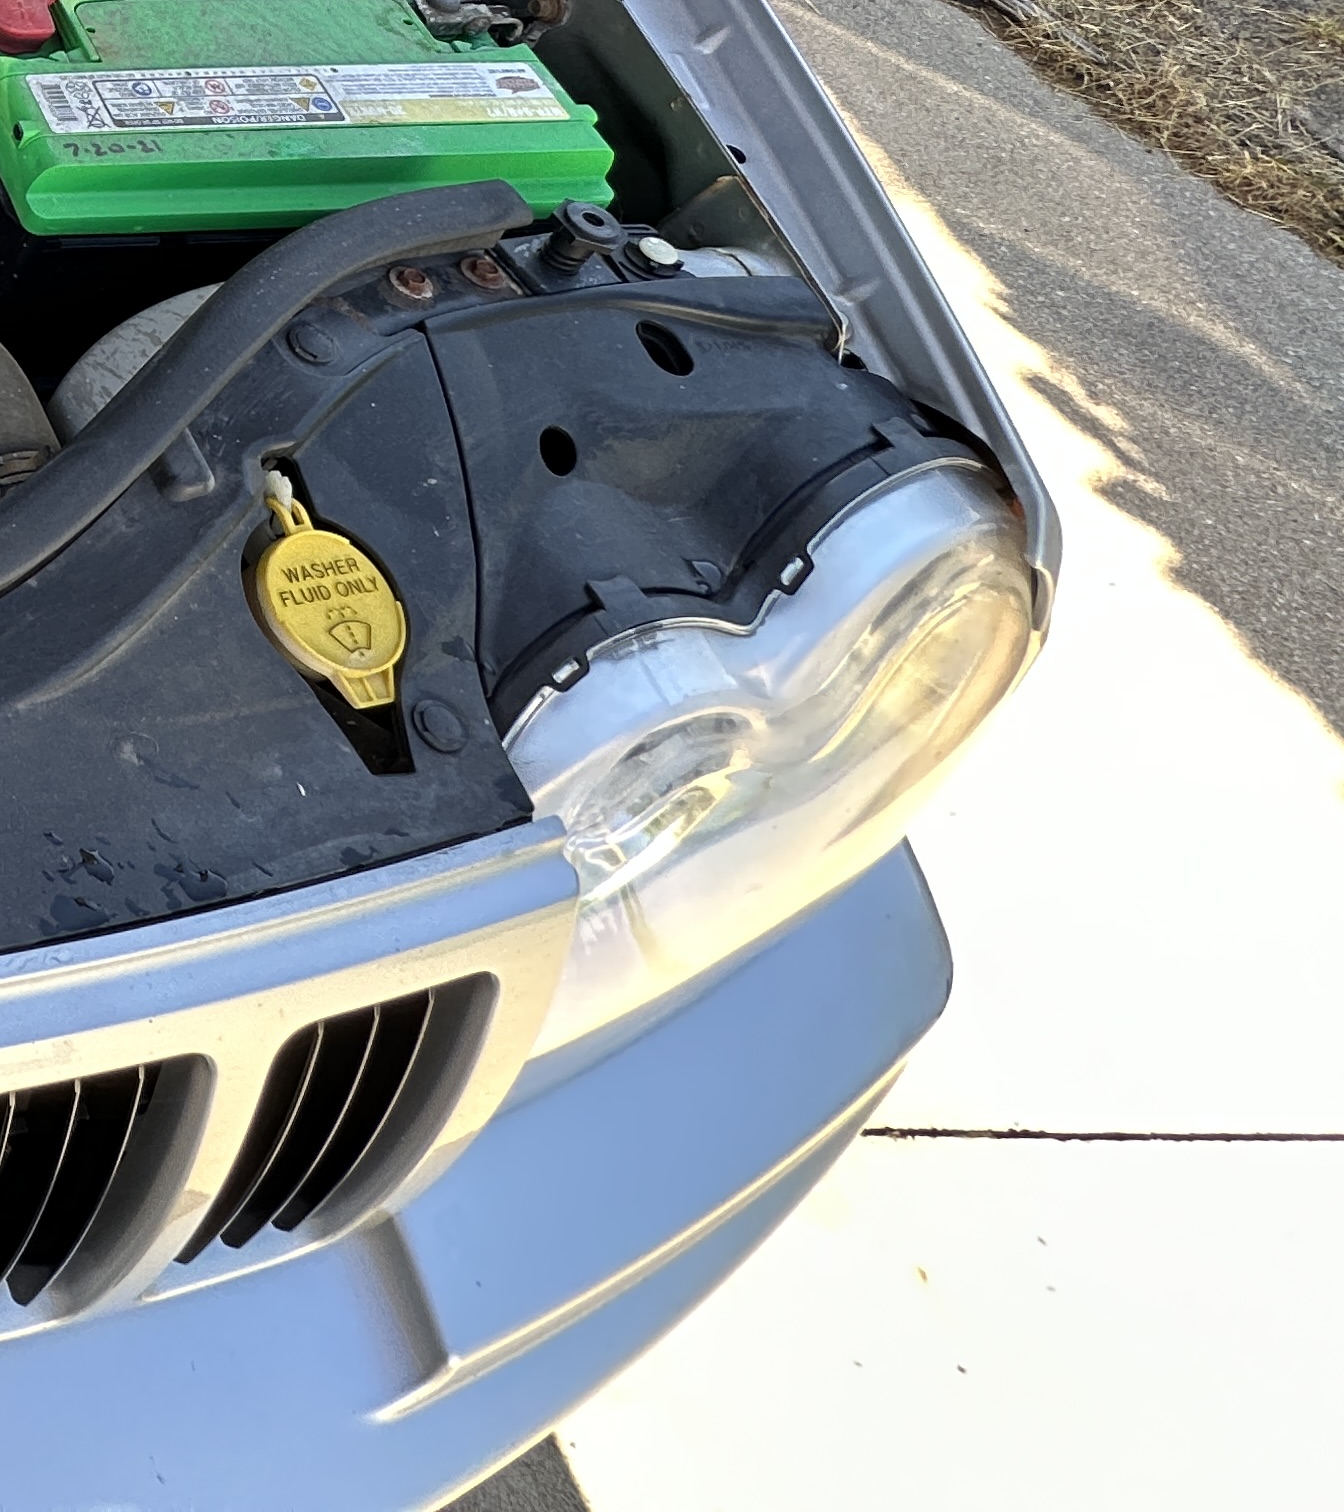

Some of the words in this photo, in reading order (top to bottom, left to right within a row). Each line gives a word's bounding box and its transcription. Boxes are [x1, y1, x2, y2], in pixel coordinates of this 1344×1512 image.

[282, 557, 360, 584] WASHER
[279, 584, 332, 608] FLUID
[334, 575, 380, 599] ONLY
